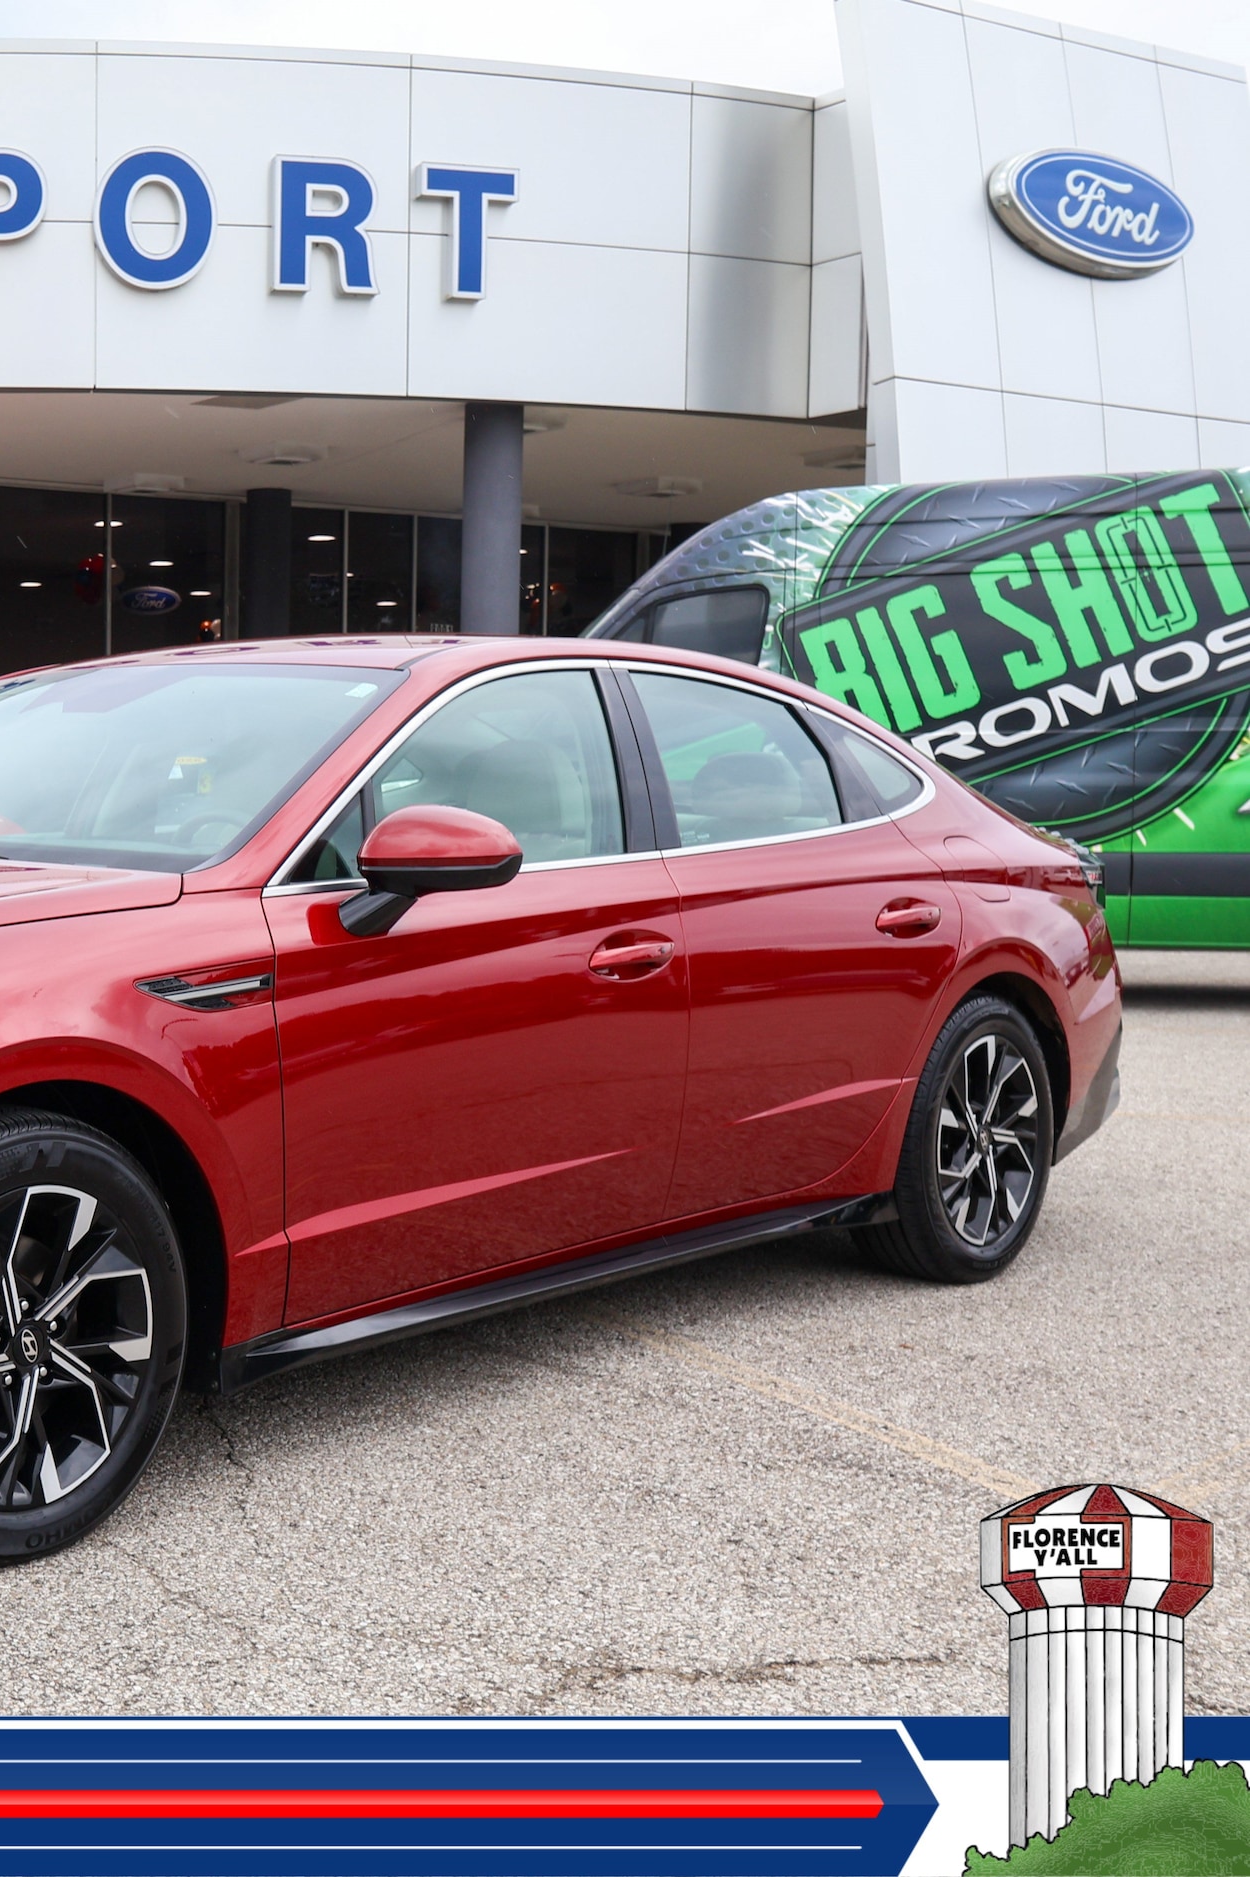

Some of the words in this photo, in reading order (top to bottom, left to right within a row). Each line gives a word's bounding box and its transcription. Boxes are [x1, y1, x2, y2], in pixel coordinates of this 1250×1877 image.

[1057, 169, 1160, 246] Ford
[131, 592, 167, 609] Ford
[799, 584, 981, 733] BIG
[970, 483, 1250, 690] SHOT
